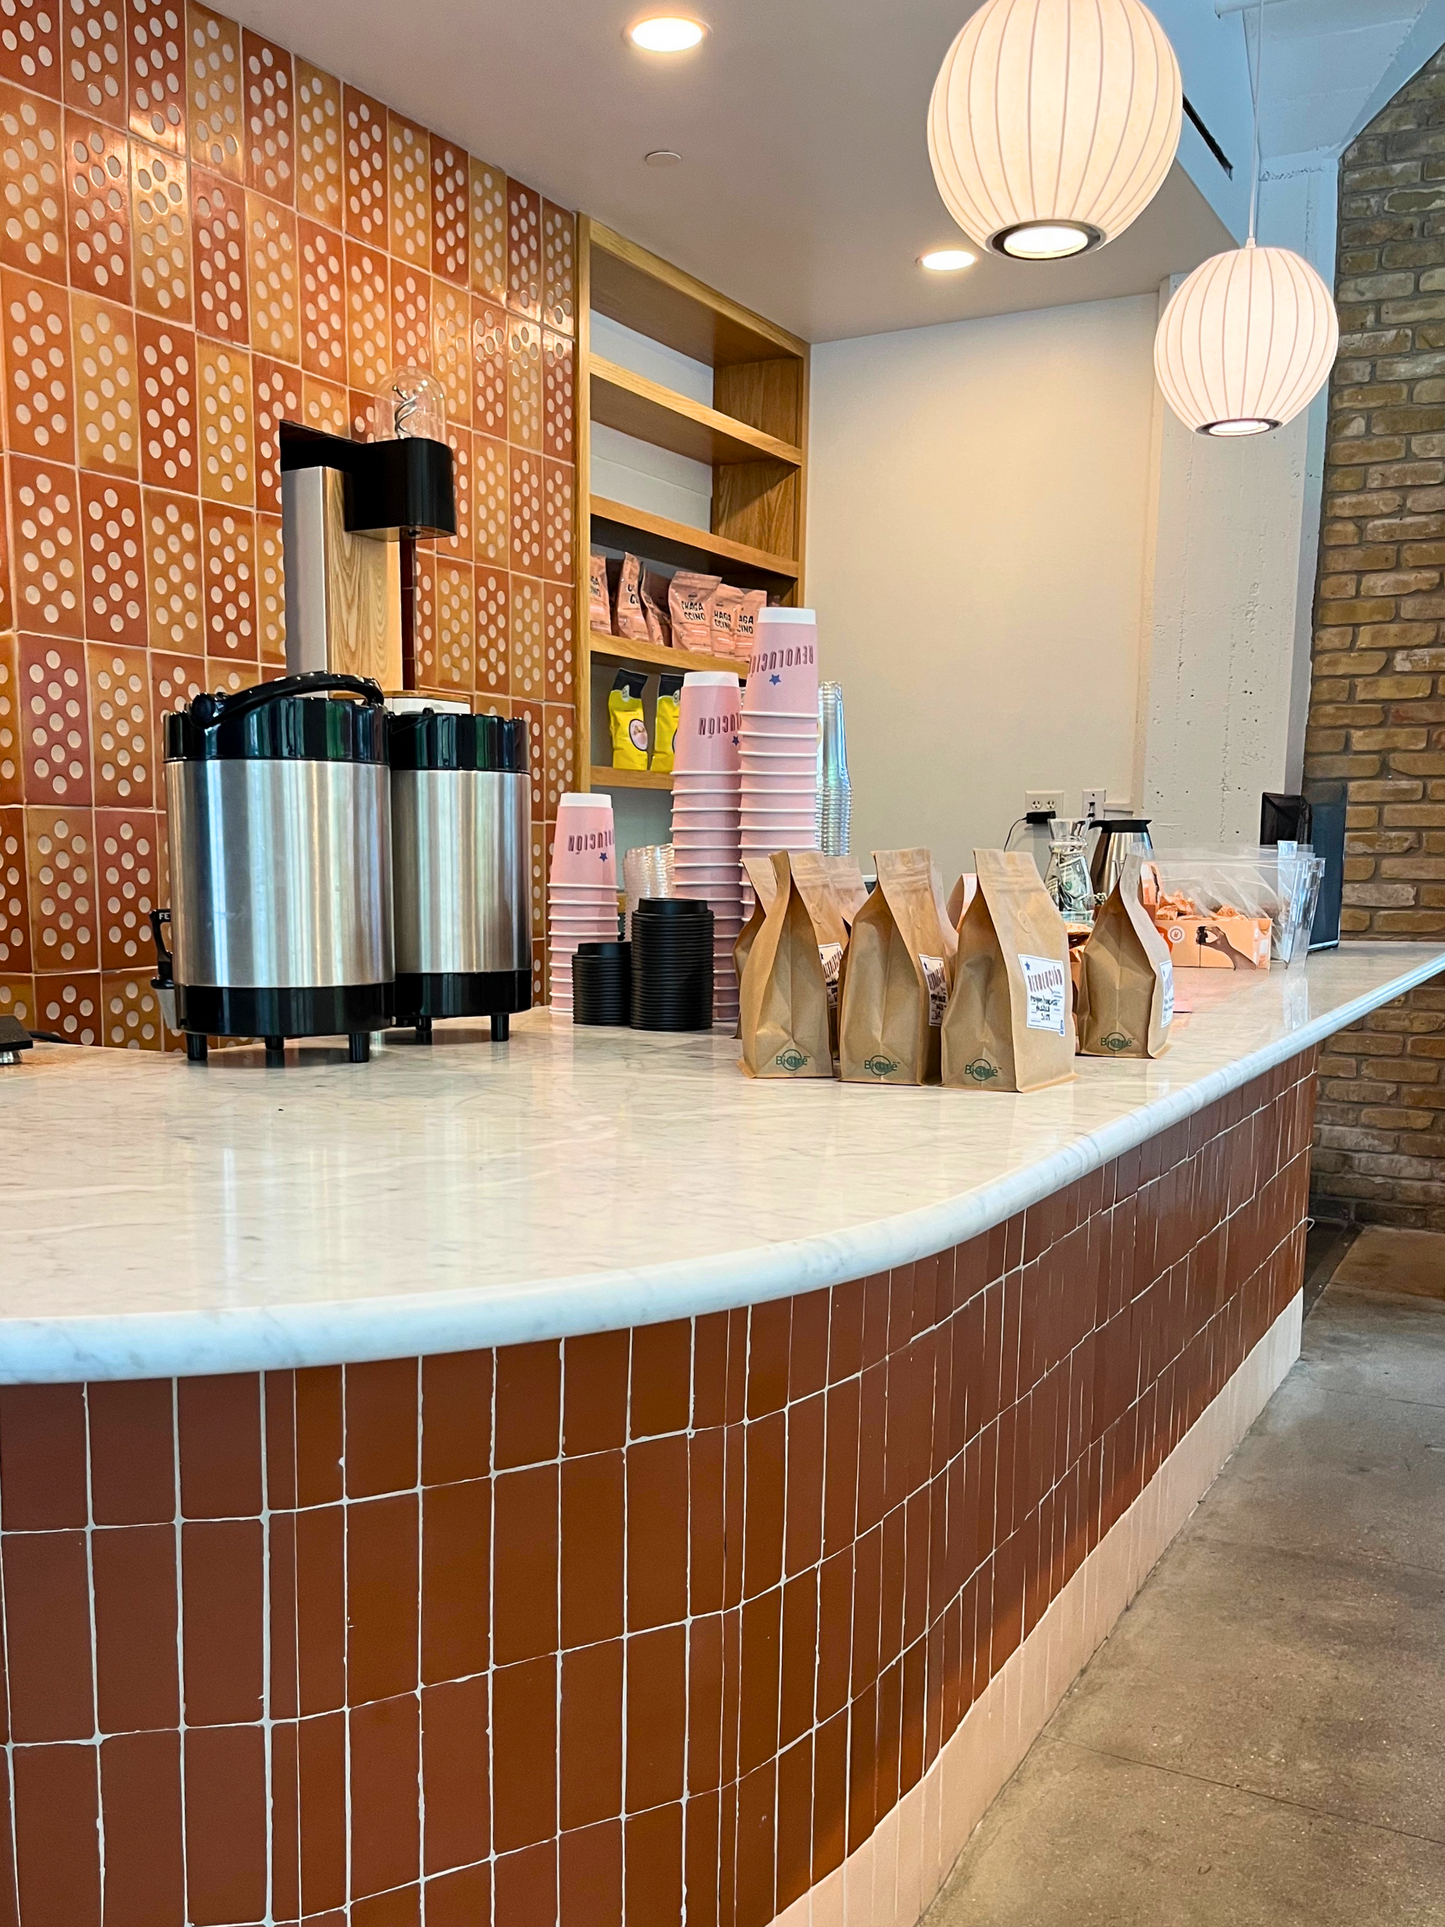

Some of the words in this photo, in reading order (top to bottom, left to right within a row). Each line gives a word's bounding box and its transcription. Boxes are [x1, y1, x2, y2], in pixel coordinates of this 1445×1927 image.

[684, 611, 706, 621] CCINO
[714, 610, 732, 621] HAGA
[739, 614, 754, 625] AGA
[159, 912, 170, 920] FE
